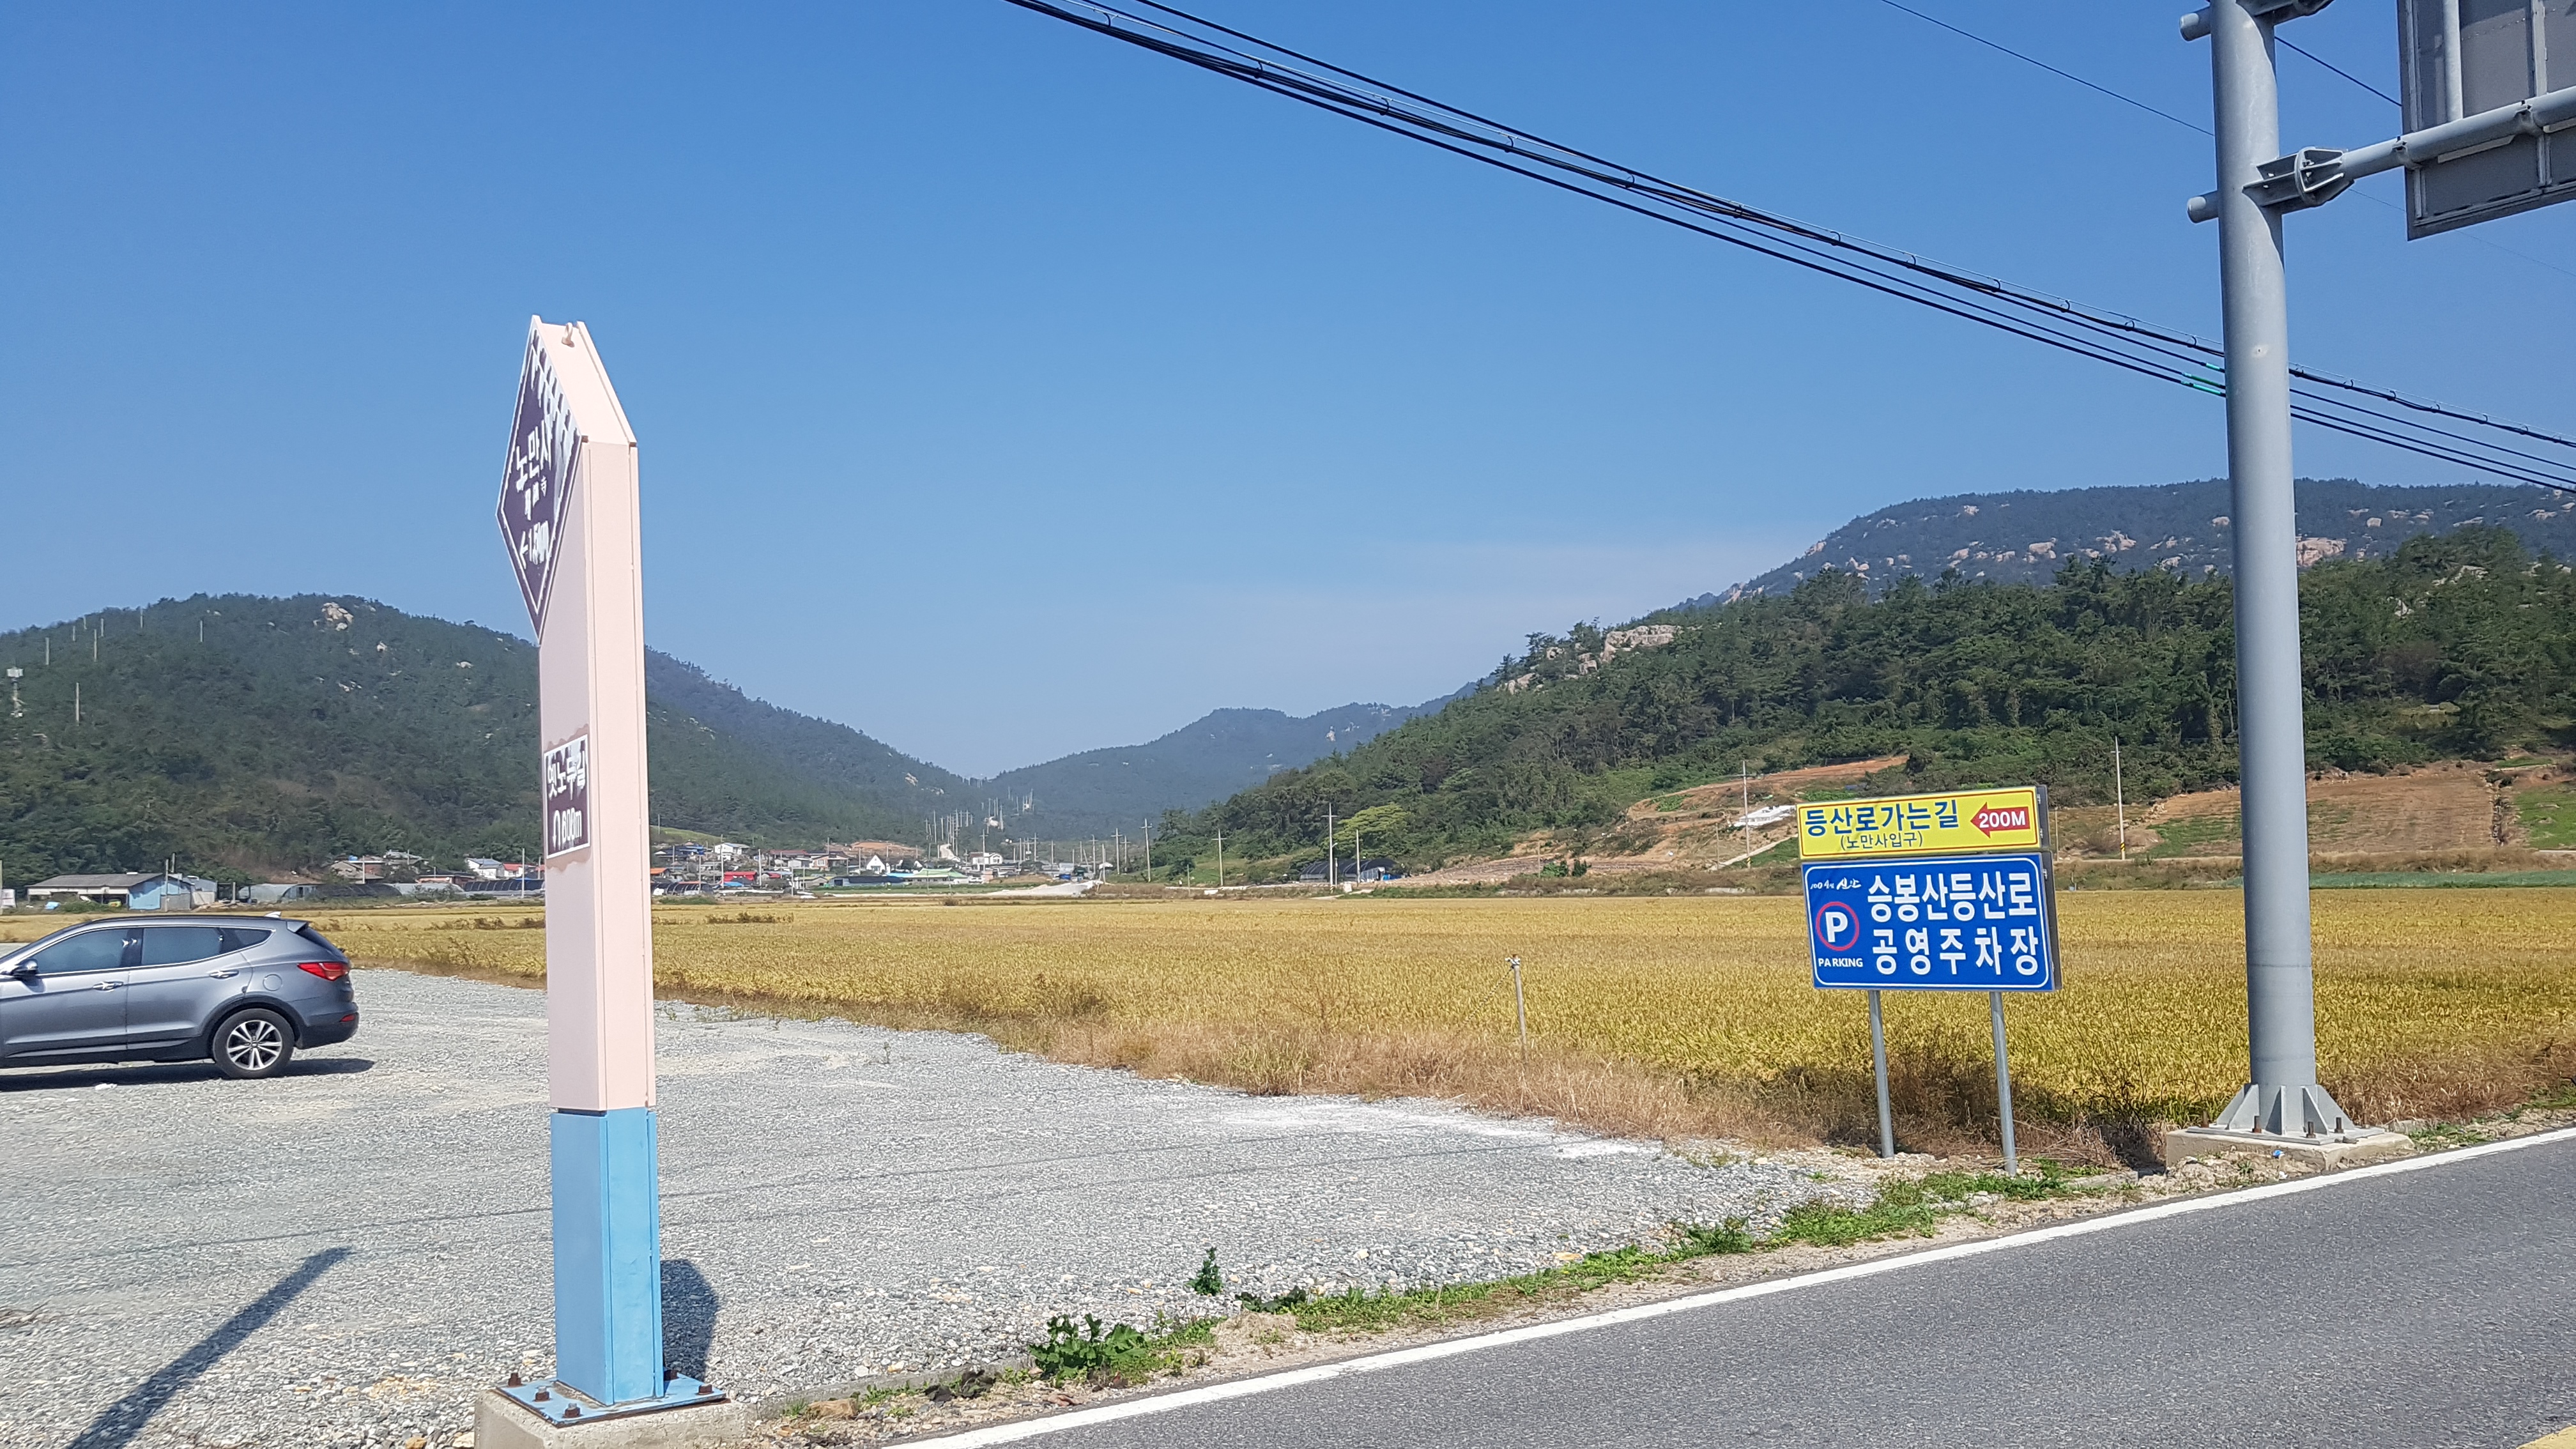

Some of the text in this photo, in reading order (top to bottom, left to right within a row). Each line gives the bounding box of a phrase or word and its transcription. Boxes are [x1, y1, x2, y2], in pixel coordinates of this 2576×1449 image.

[516, 420, 552, 492] 노만사
[1805, 799, 1959, 837] 등산로가는길
[1979, 811, 2027, 829] 200M
[1840, 831, 1923, 850] (노만사입구)
[1867, 871, 2037, 923] 승봉산등산로
[1825, 911, 1848, 943] P
[1818, 958, 1864, 968] PARKING
[1872, 925, 2039, 976] 공영주차장
